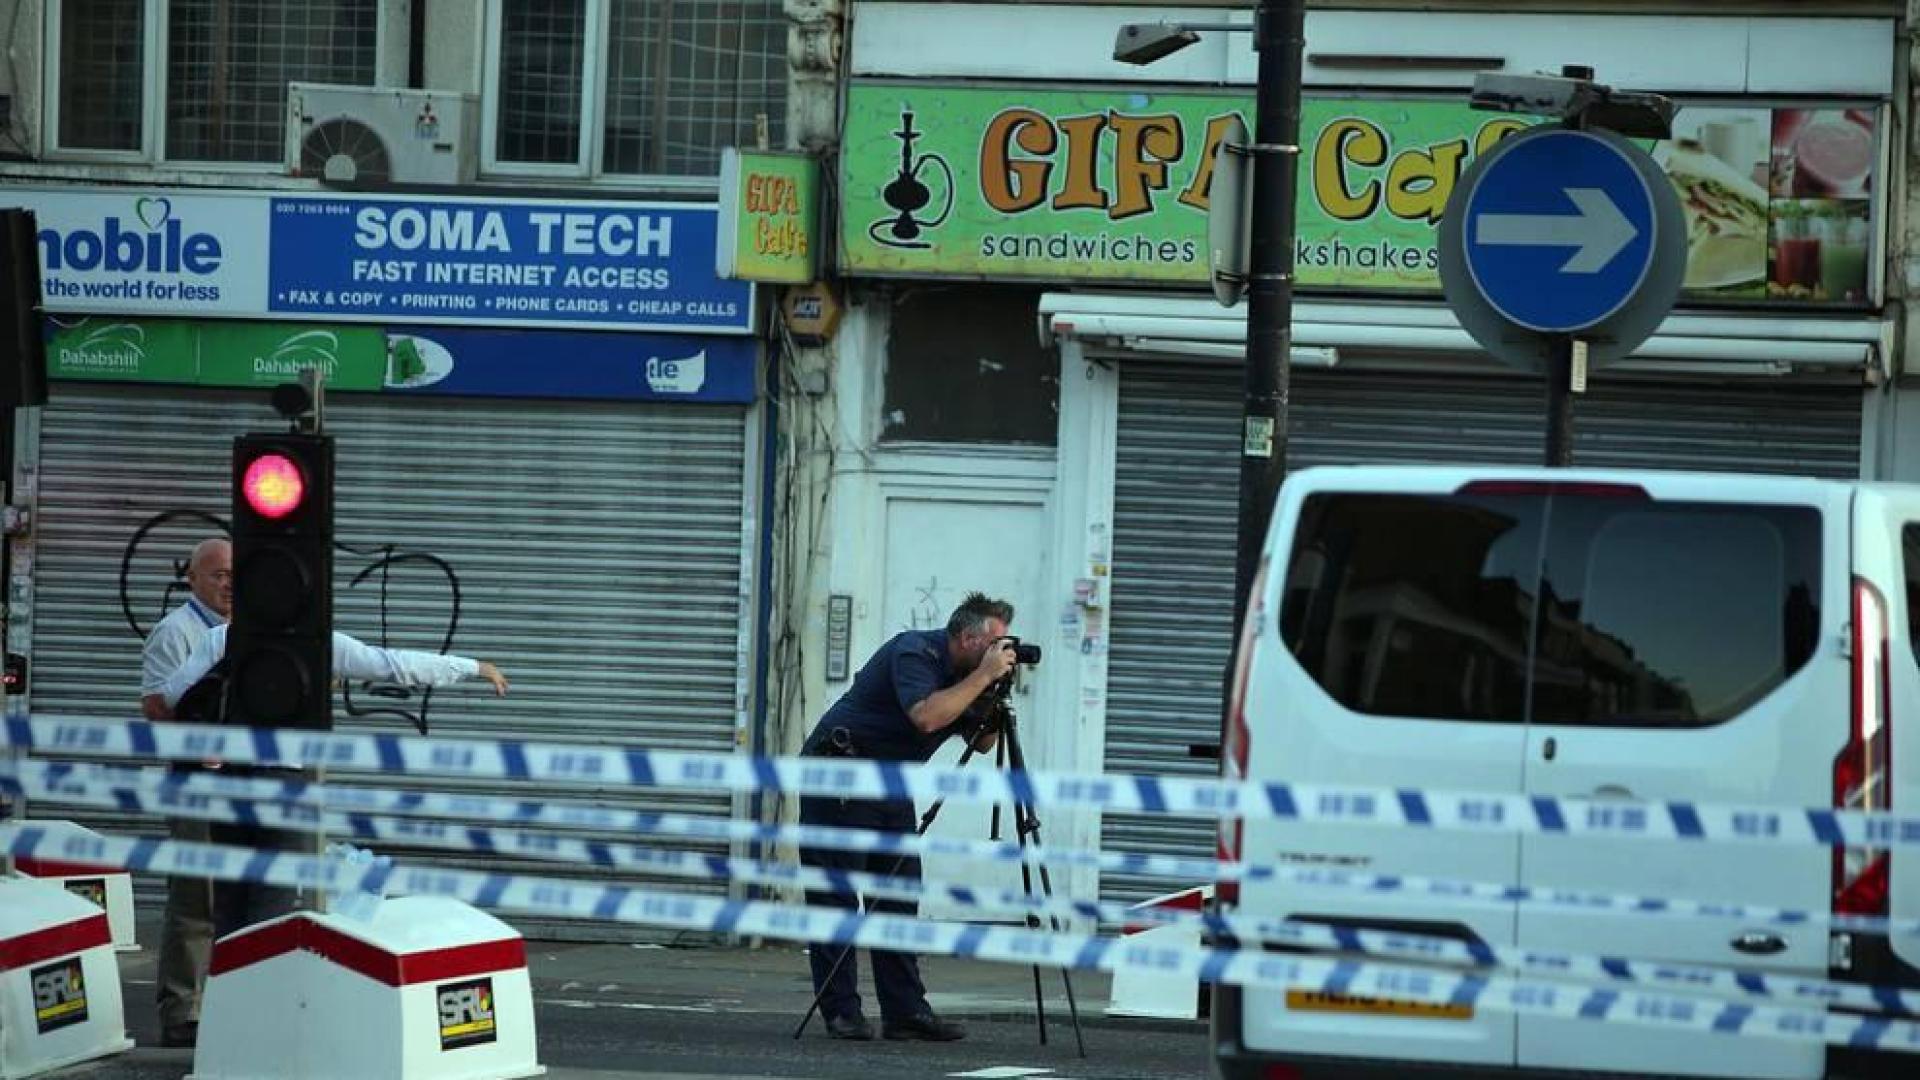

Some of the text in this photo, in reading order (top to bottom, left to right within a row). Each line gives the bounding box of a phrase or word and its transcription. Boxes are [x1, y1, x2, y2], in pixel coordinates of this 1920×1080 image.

[1314, 118, 1531, 225] Ca
[746, 174, 800, 215] GIFA
[355, 207, 671, 257] SOMA TECH
[982, 234, 1195, 262] sandwiches
[46, 279, 219, 300] the world for less
[353, 260, 669, 290] FAST INTERNET ACCESS
[289, 291, 737, 317] FAX & COPY PRINTING PHONE CARDS CHEAP CALLS
[34, 966, 83, 1010] SRL
[440, 987, 493, 1026] SRL
